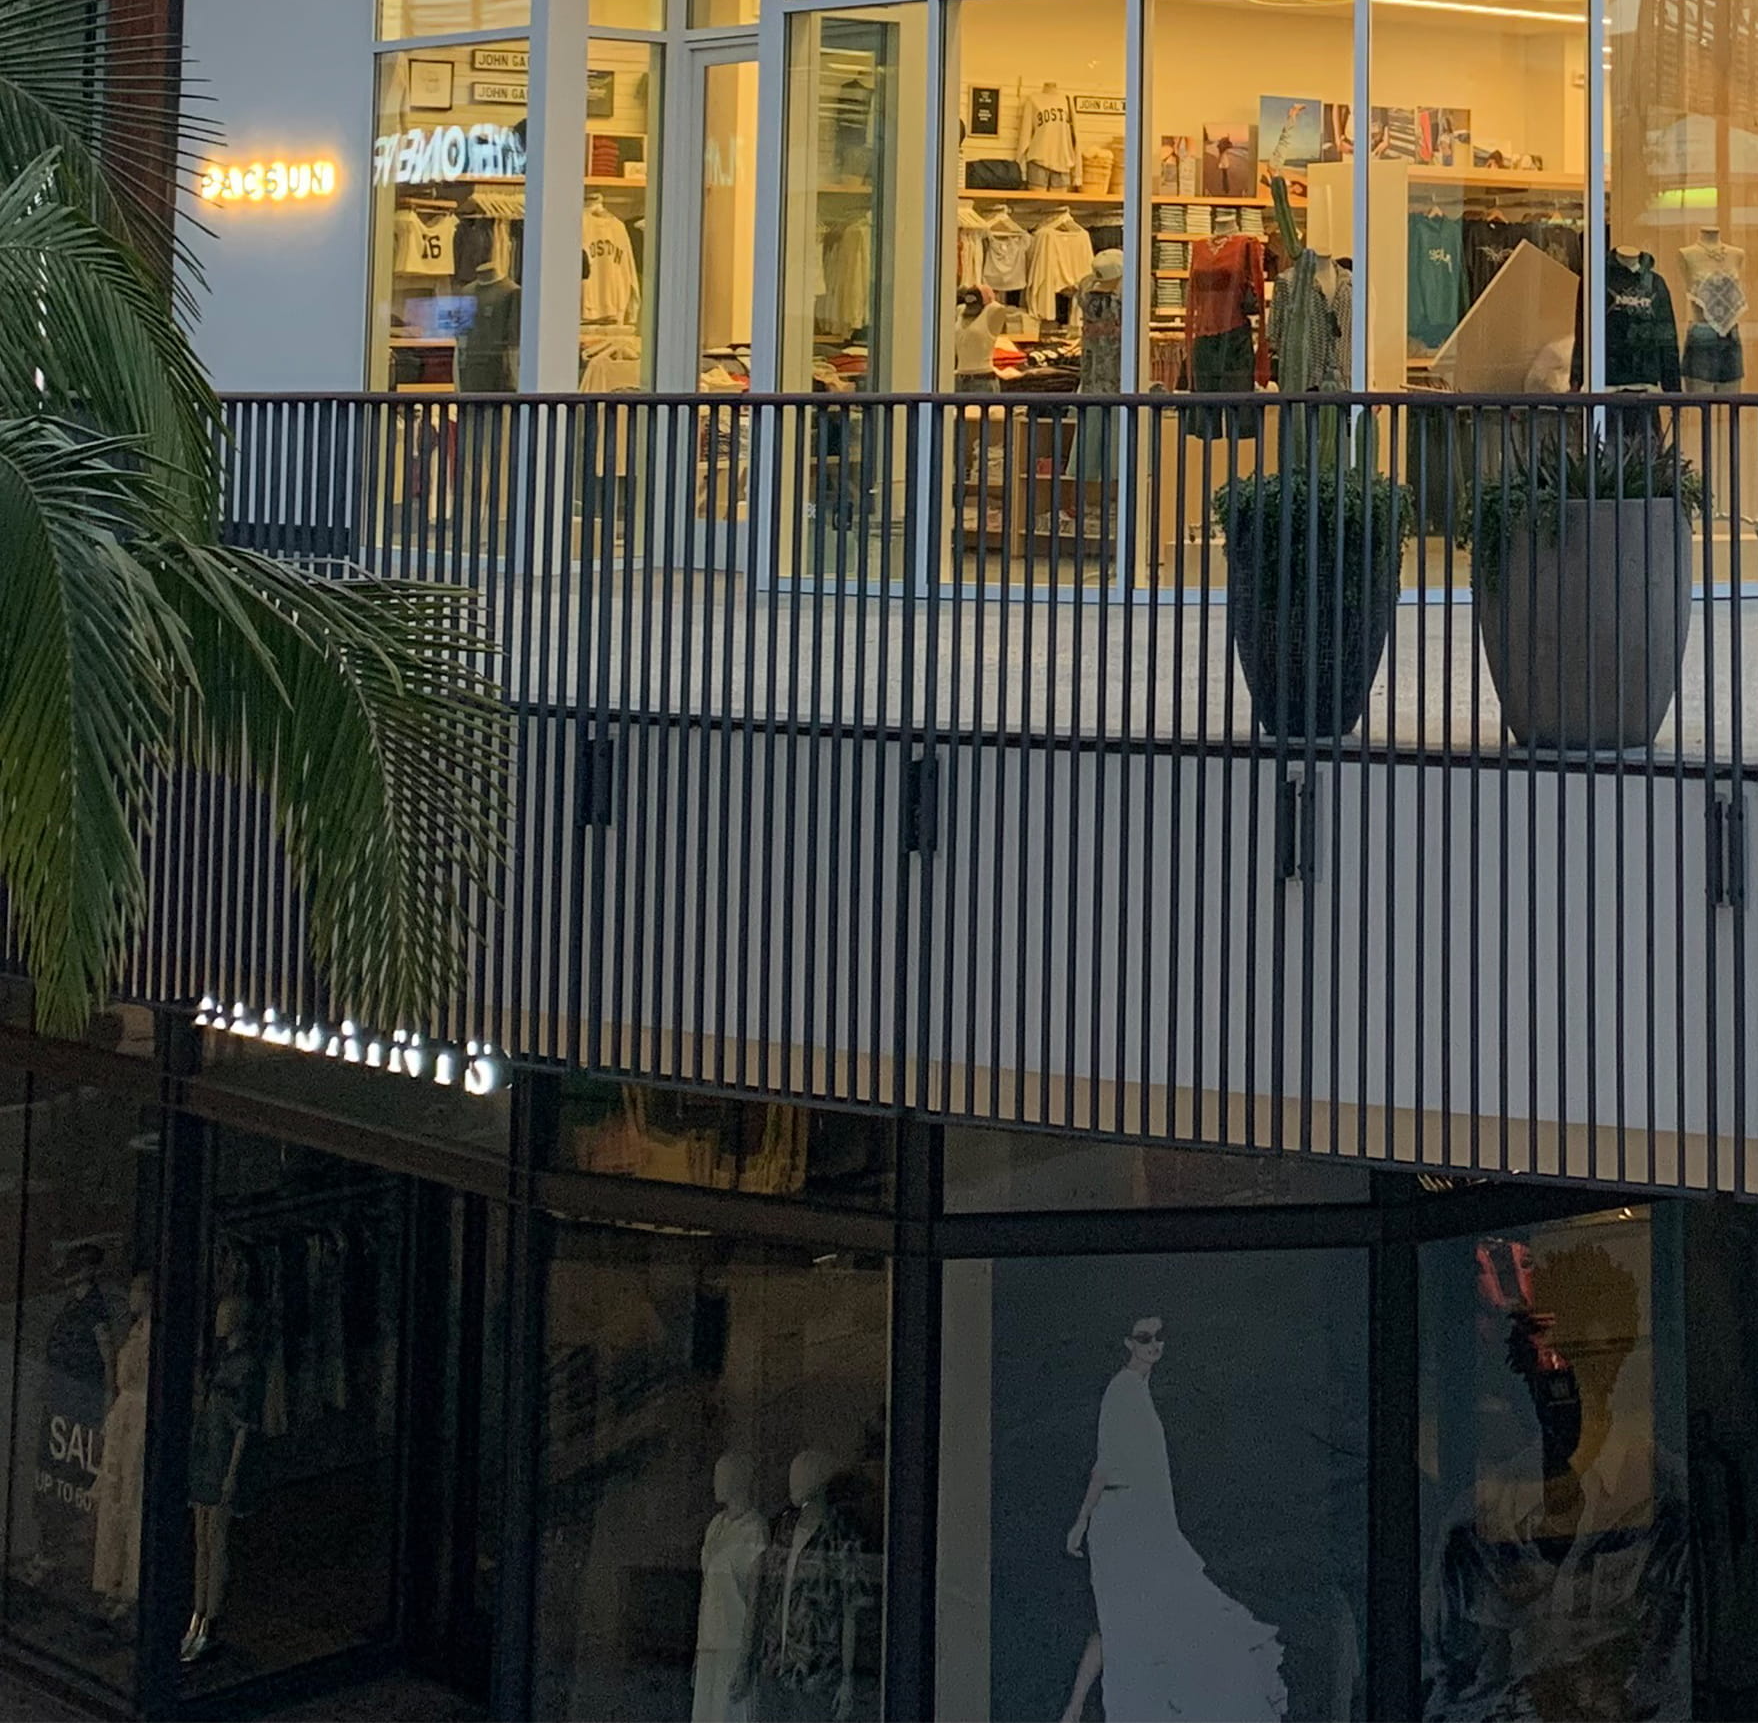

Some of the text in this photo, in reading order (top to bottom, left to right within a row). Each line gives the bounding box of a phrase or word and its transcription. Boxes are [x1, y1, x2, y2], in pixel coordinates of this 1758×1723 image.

[478, 53, 529, 67] JOHN GA
[478, 86, 528, 100] JOHN GA
[1036, 108, 1073, 127] BOST
[200, 163, 334, 200] PACSUN
[588, 238, 624, 265] OSTON
[49, 1415, 101, 1475] SAL
